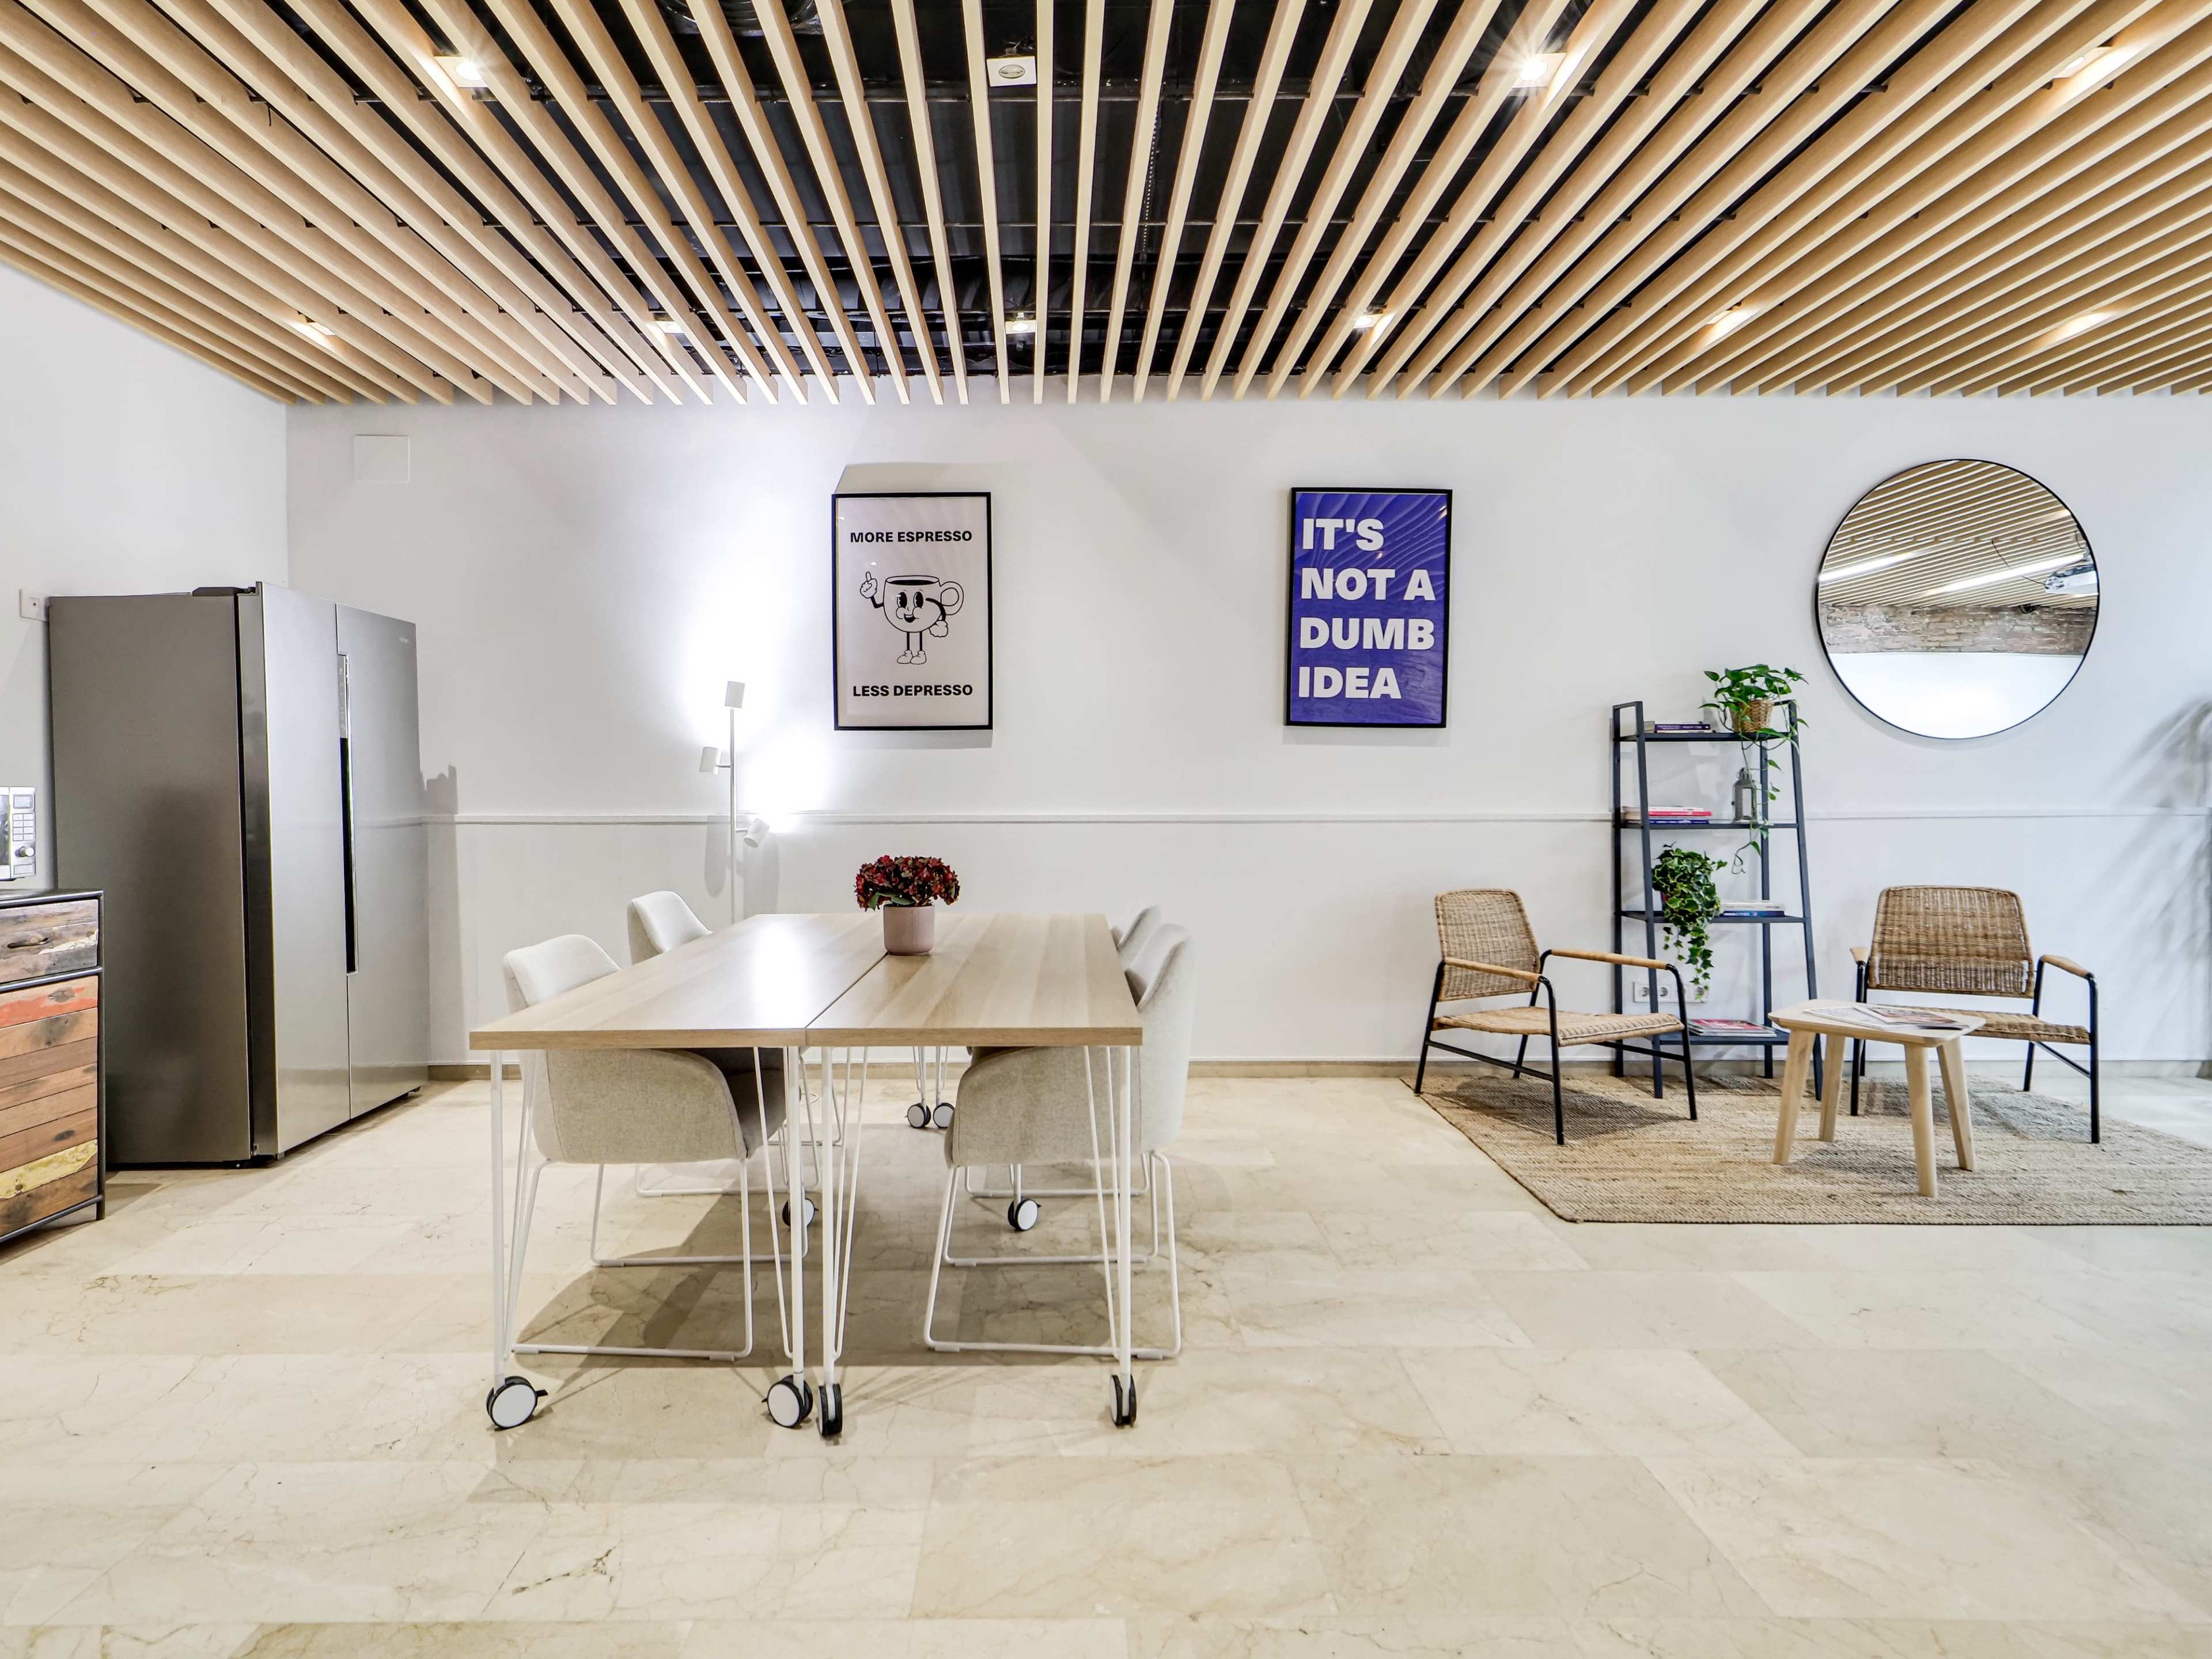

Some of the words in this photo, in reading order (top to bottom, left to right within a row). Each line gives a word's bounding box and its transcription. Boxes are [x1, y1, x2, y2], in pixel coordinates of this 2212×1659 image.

[850, 532, 893, 543] MORE
[897, 530, 973, 543] ESPRESSO
[1302, 518, 1384, 551] IT'S
[1301, 567, 1396, 601] NOT
[1403, 569, 1436, 601] A
[1300, 617, 1435, 650] DUMB
[853, 685, 890, 697] LESS
[893, 684, 974, 697] DEPRESSO
[1298, 666, 1402, 699] IDEA
